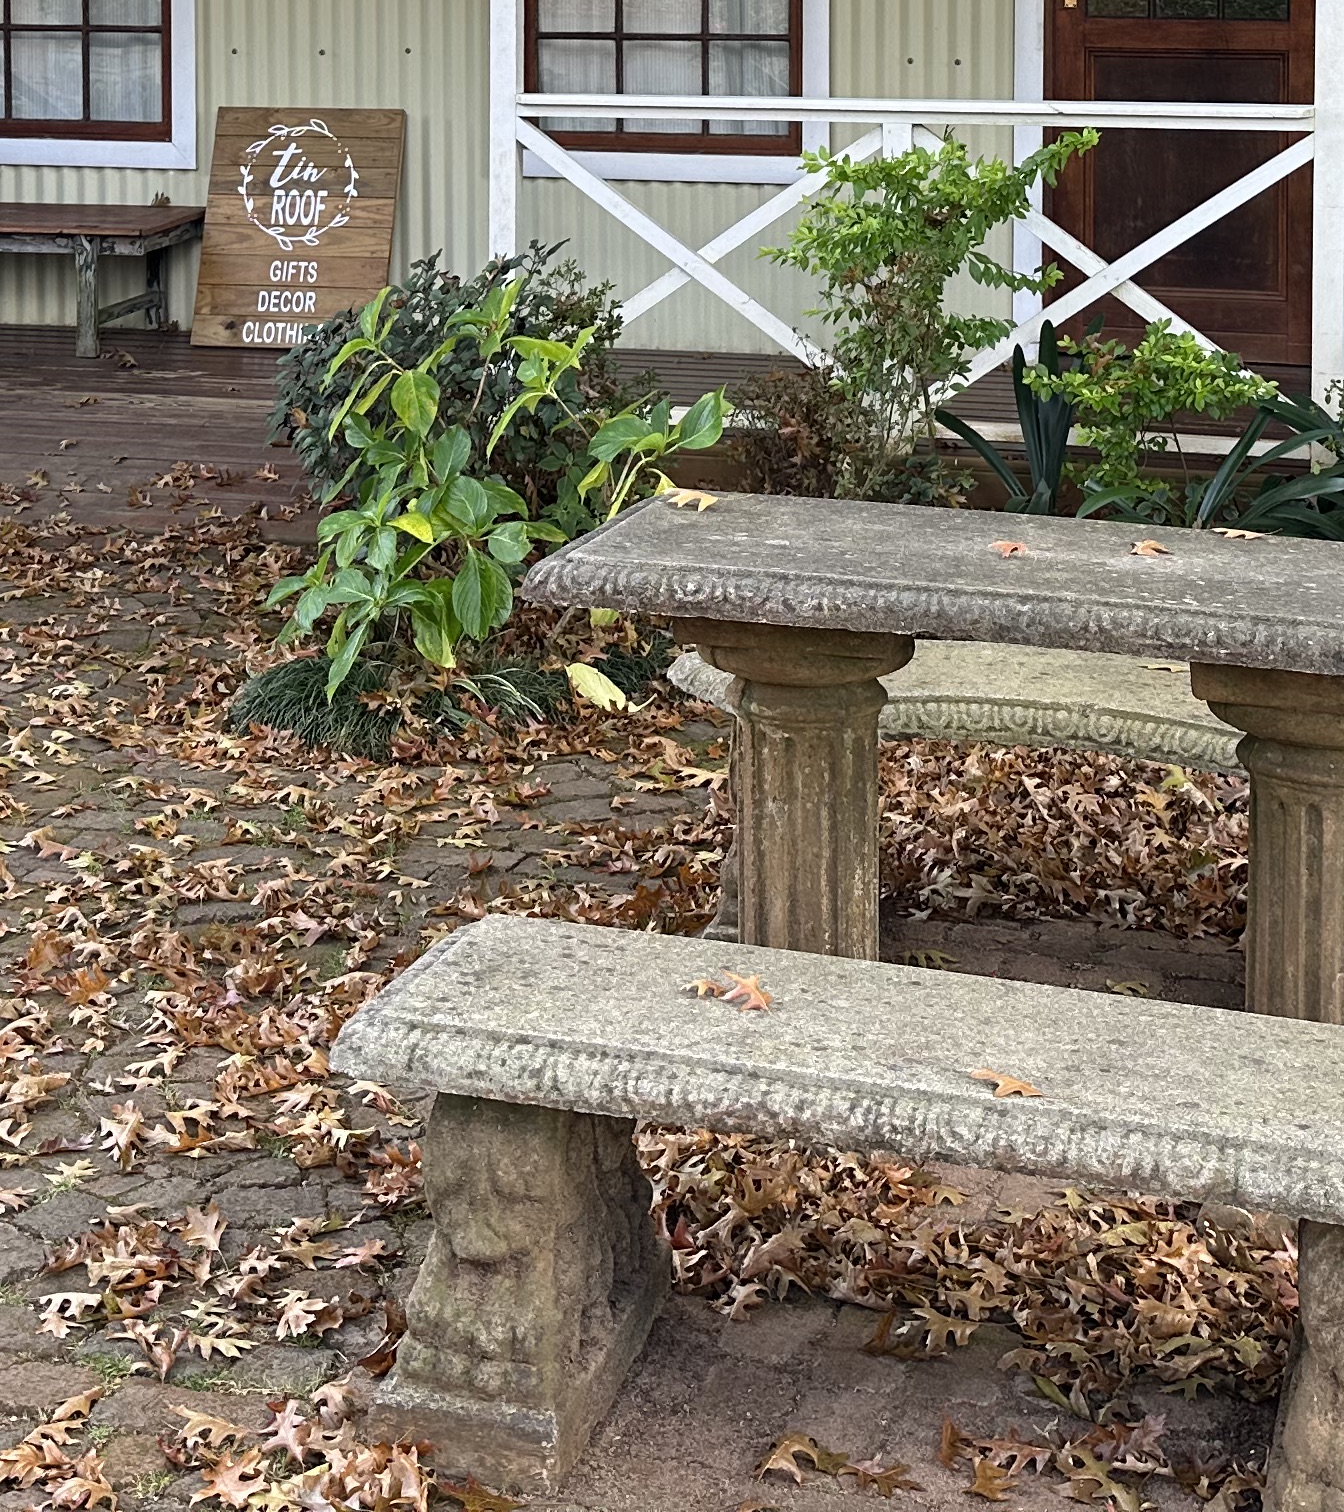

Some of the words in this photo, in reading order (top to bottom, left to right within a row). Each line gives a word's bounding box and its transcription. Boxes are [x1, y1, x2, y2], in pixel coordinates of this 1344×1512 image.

[270, 189, 329, 226] ROOF
[269, 260, 318, 283] GIFTS
[257, 290, 317, 313] DECOR
[242, 321, 324, 344] CLOTHI
